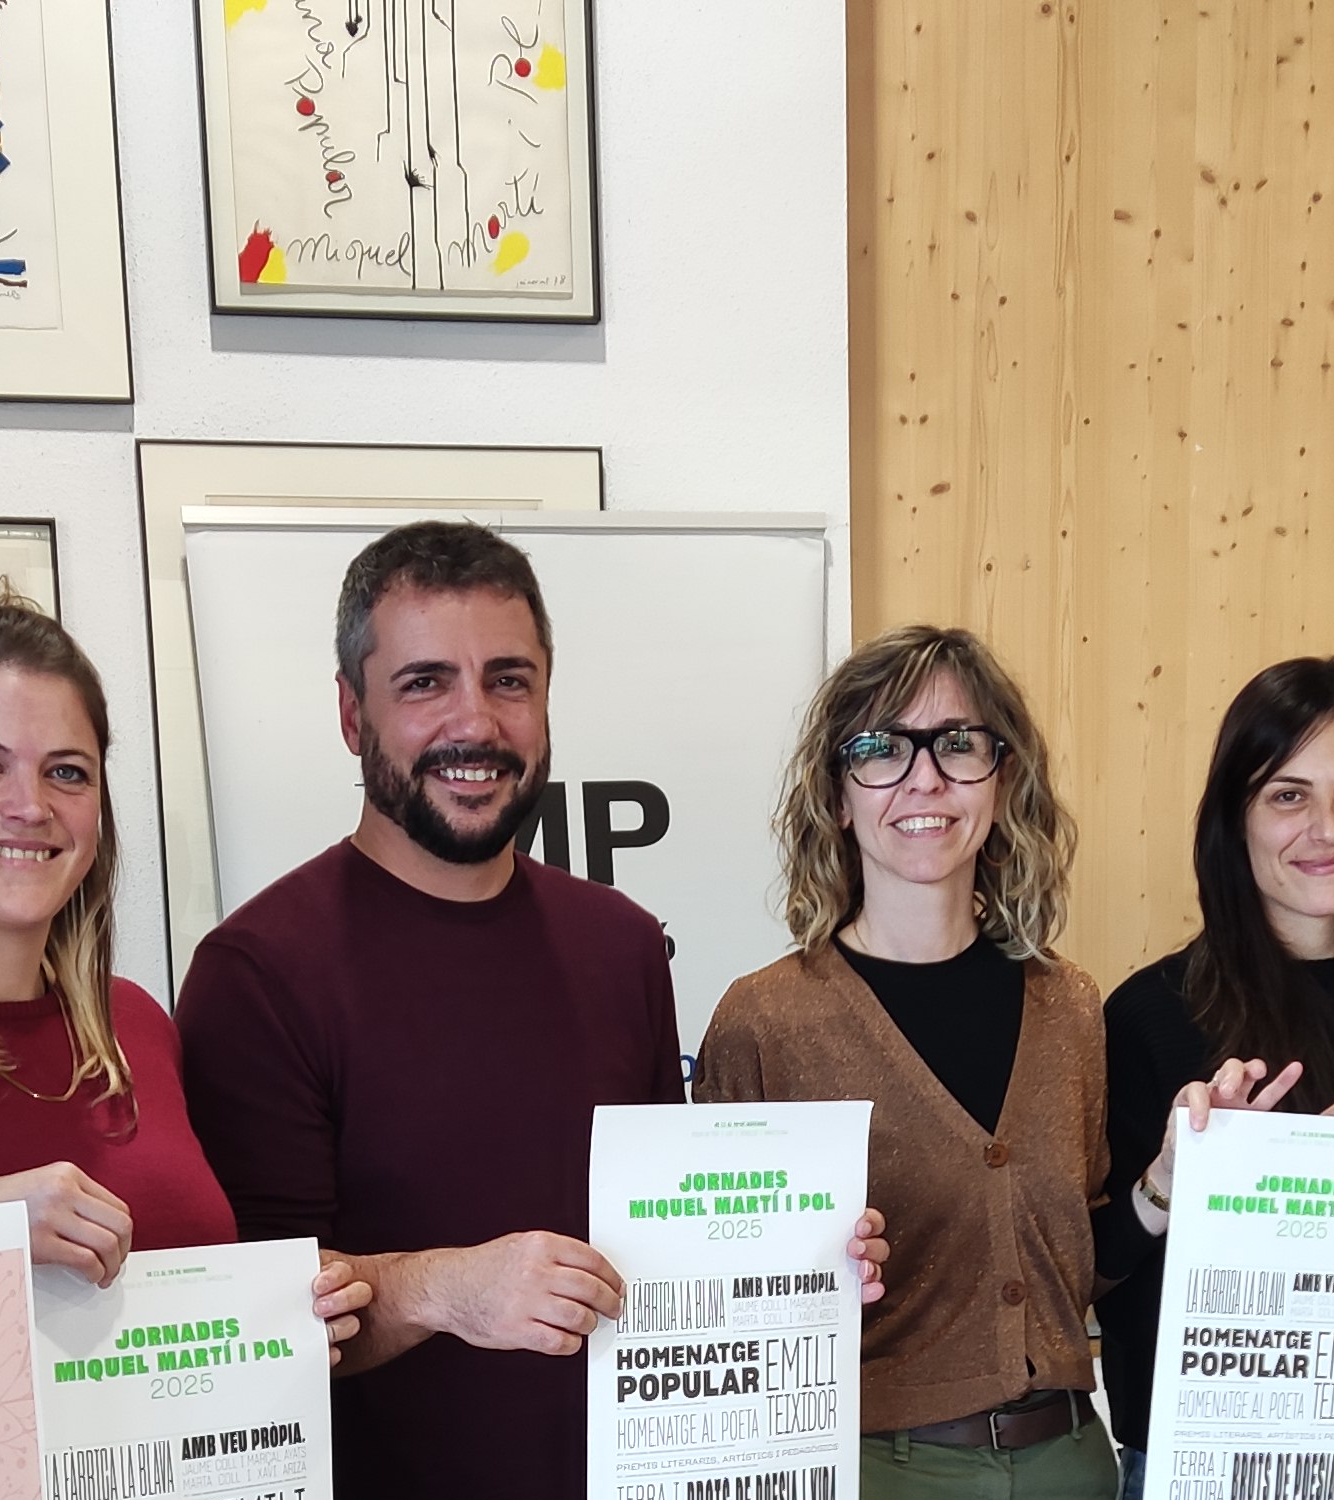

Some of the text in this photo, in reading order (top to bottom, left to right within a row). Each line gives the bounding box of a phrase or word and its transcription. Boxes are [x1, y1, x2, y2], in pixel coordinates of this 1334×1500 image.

[286, 232, 411, 280] Miquel
[679, 1170, 787, 1192] JORNADES
[630, 1191, 834, 1220] MIQUEL MARTÍ I POL
[1208, 1195, 1279, 1215] MIQUEL
[708, 1219, 762, 1240] 2025
[1276, 1220, 1327, 1239] 2025
[733, 1269, 839, 1299] AMB VEU PRÒPIA.
[115, 1317, 240, 1350] JORNADES
[1183, 1327, 1311, 1350] HOMENATGE
[55, 1338, 293, 1382] MIQUEL MARTÍ I POL
[617, 1340, 759, 1370] HOMENATGE
[766, 1334, 837, 1391] EMILI
[1181, 1351, 1309, 1379] POPULAR
[151, 1372, 213, 1400] 2025
[617, 1367, 759, 1403] POPULAR
[766, 1389, 837, 1436] TEIXIDOR
[182, 1422, 306, 1460] AMB VEU PRÒPIA.
[120, 1445, 136, 1500] LA
[138, 1440, 175, 1497] BLAVA
